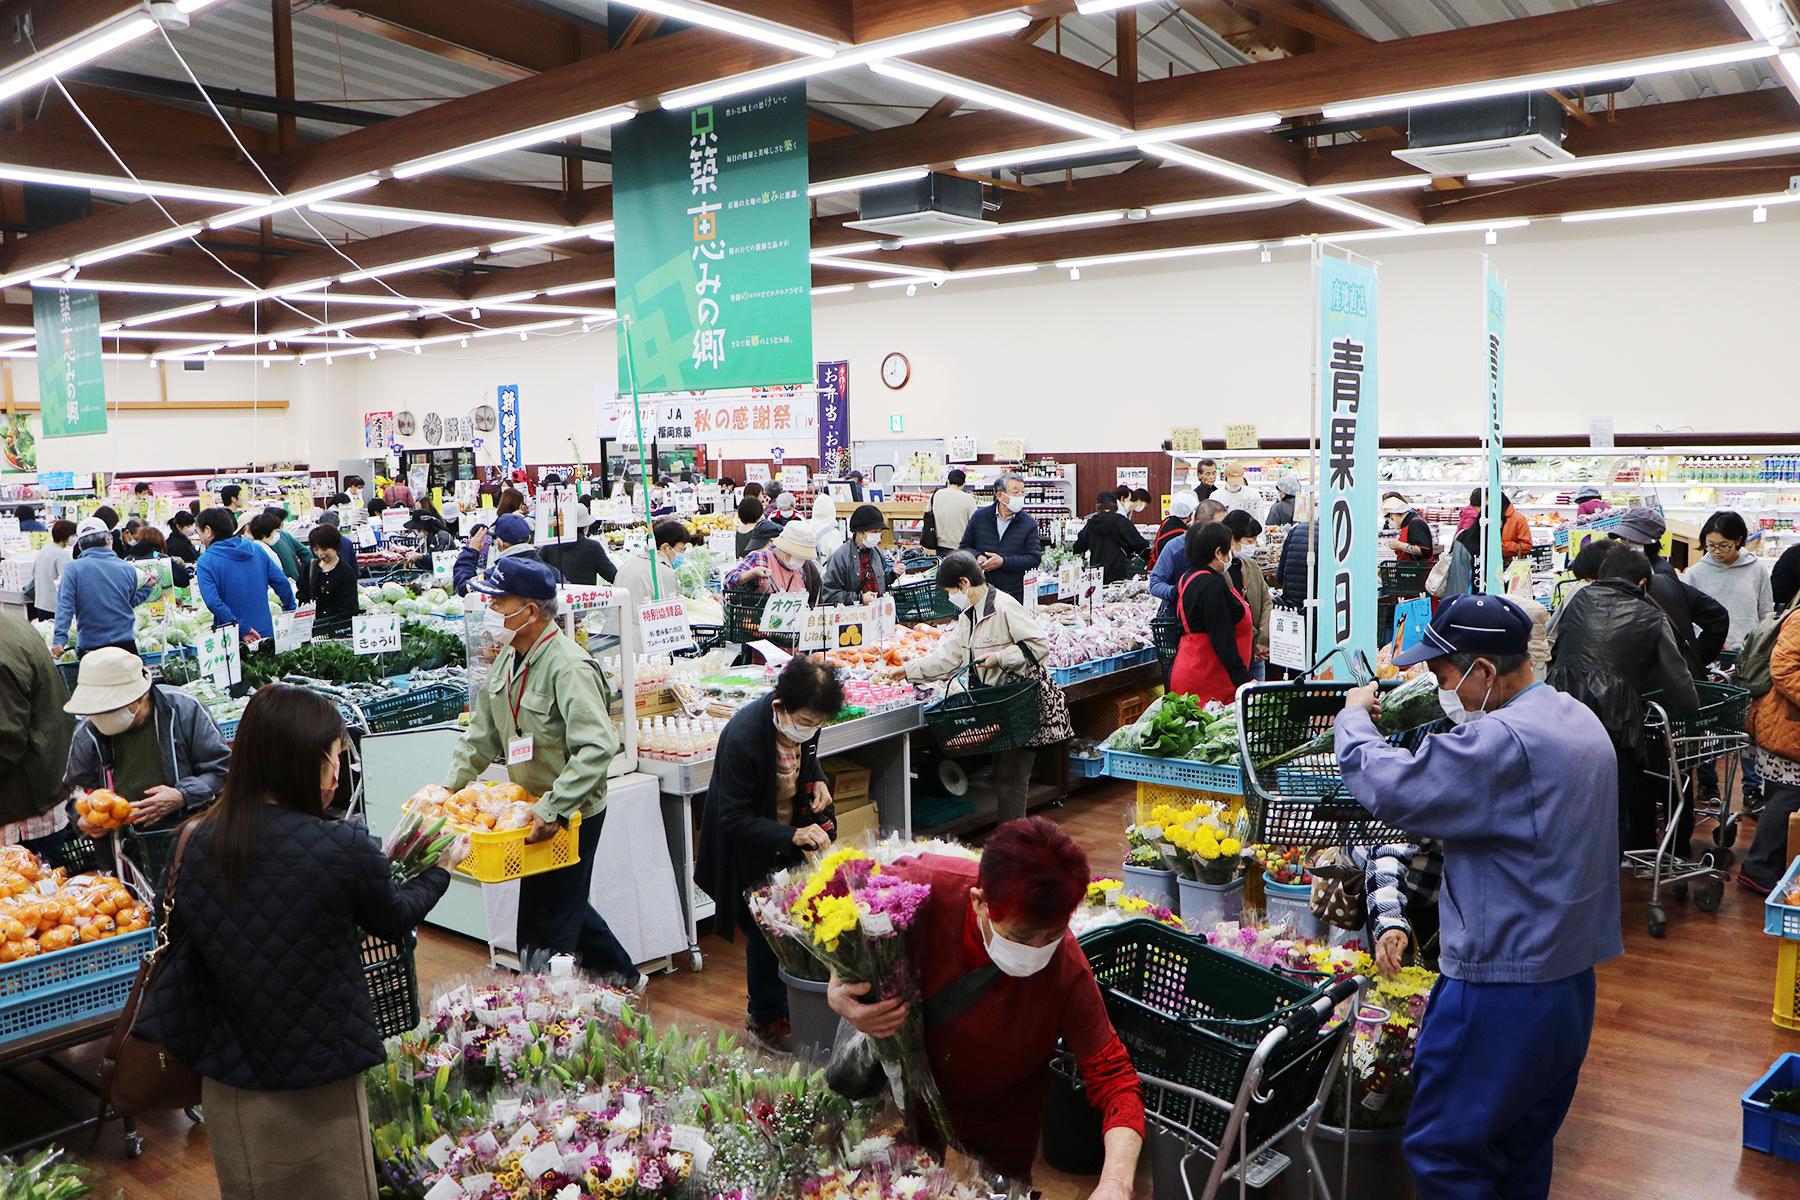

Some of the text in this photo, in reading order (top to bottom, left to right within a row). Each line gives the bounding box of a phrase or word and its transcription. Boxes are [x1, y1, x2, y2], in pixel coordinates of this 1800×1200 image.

[667, 408, 682, 420] JA
[693, 404, 791, 432] 秋の感謝祭
[657, 426, 692, 438] 福岡京築
[1329, 337, 1364, 645] 青果の日
[771, 599, 802, 613] オクラ
[359, 635, 396, 649] きゅうり
